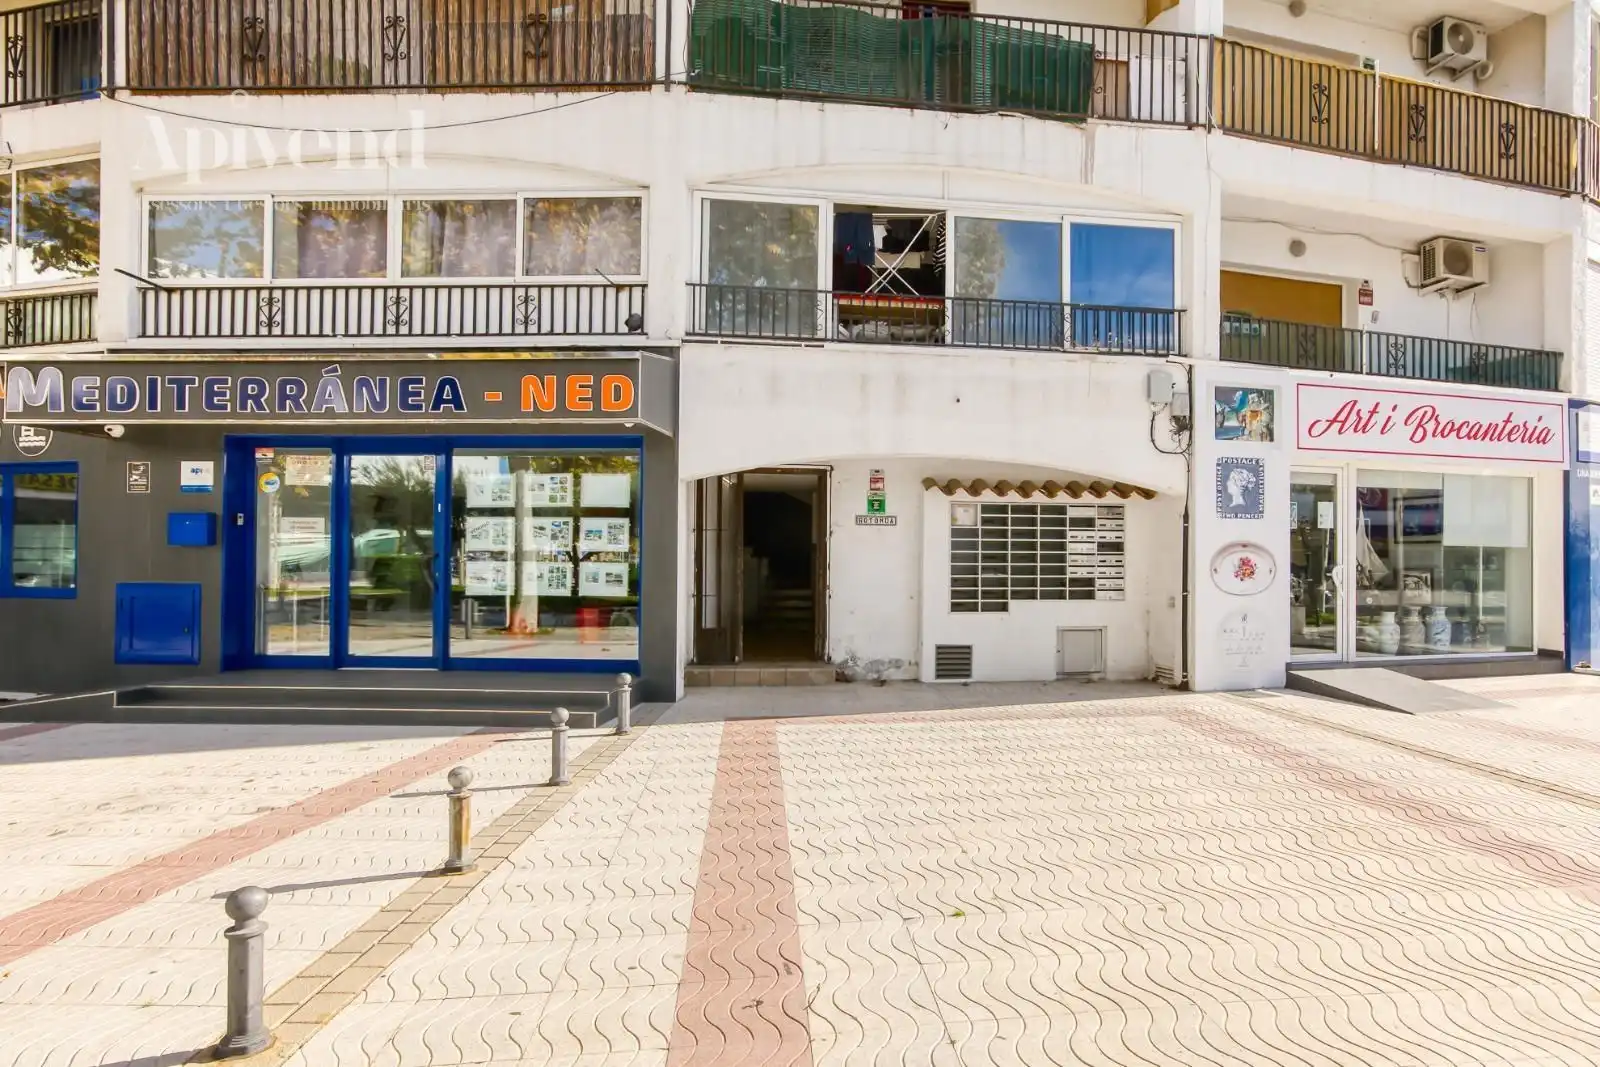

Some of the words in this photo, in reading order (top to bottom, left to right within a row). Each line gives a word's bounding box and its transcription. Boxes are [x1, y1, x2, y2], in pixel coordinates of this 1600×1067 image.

[6, 363, 468, 413] MEDITERRÁNEA
[520, 374, 635, 412] NED
[1308, 399, 1381, 438] Art
[1380, 404, 1398, 435] i
[1403, 404, 1556, 446] Brocanteria
